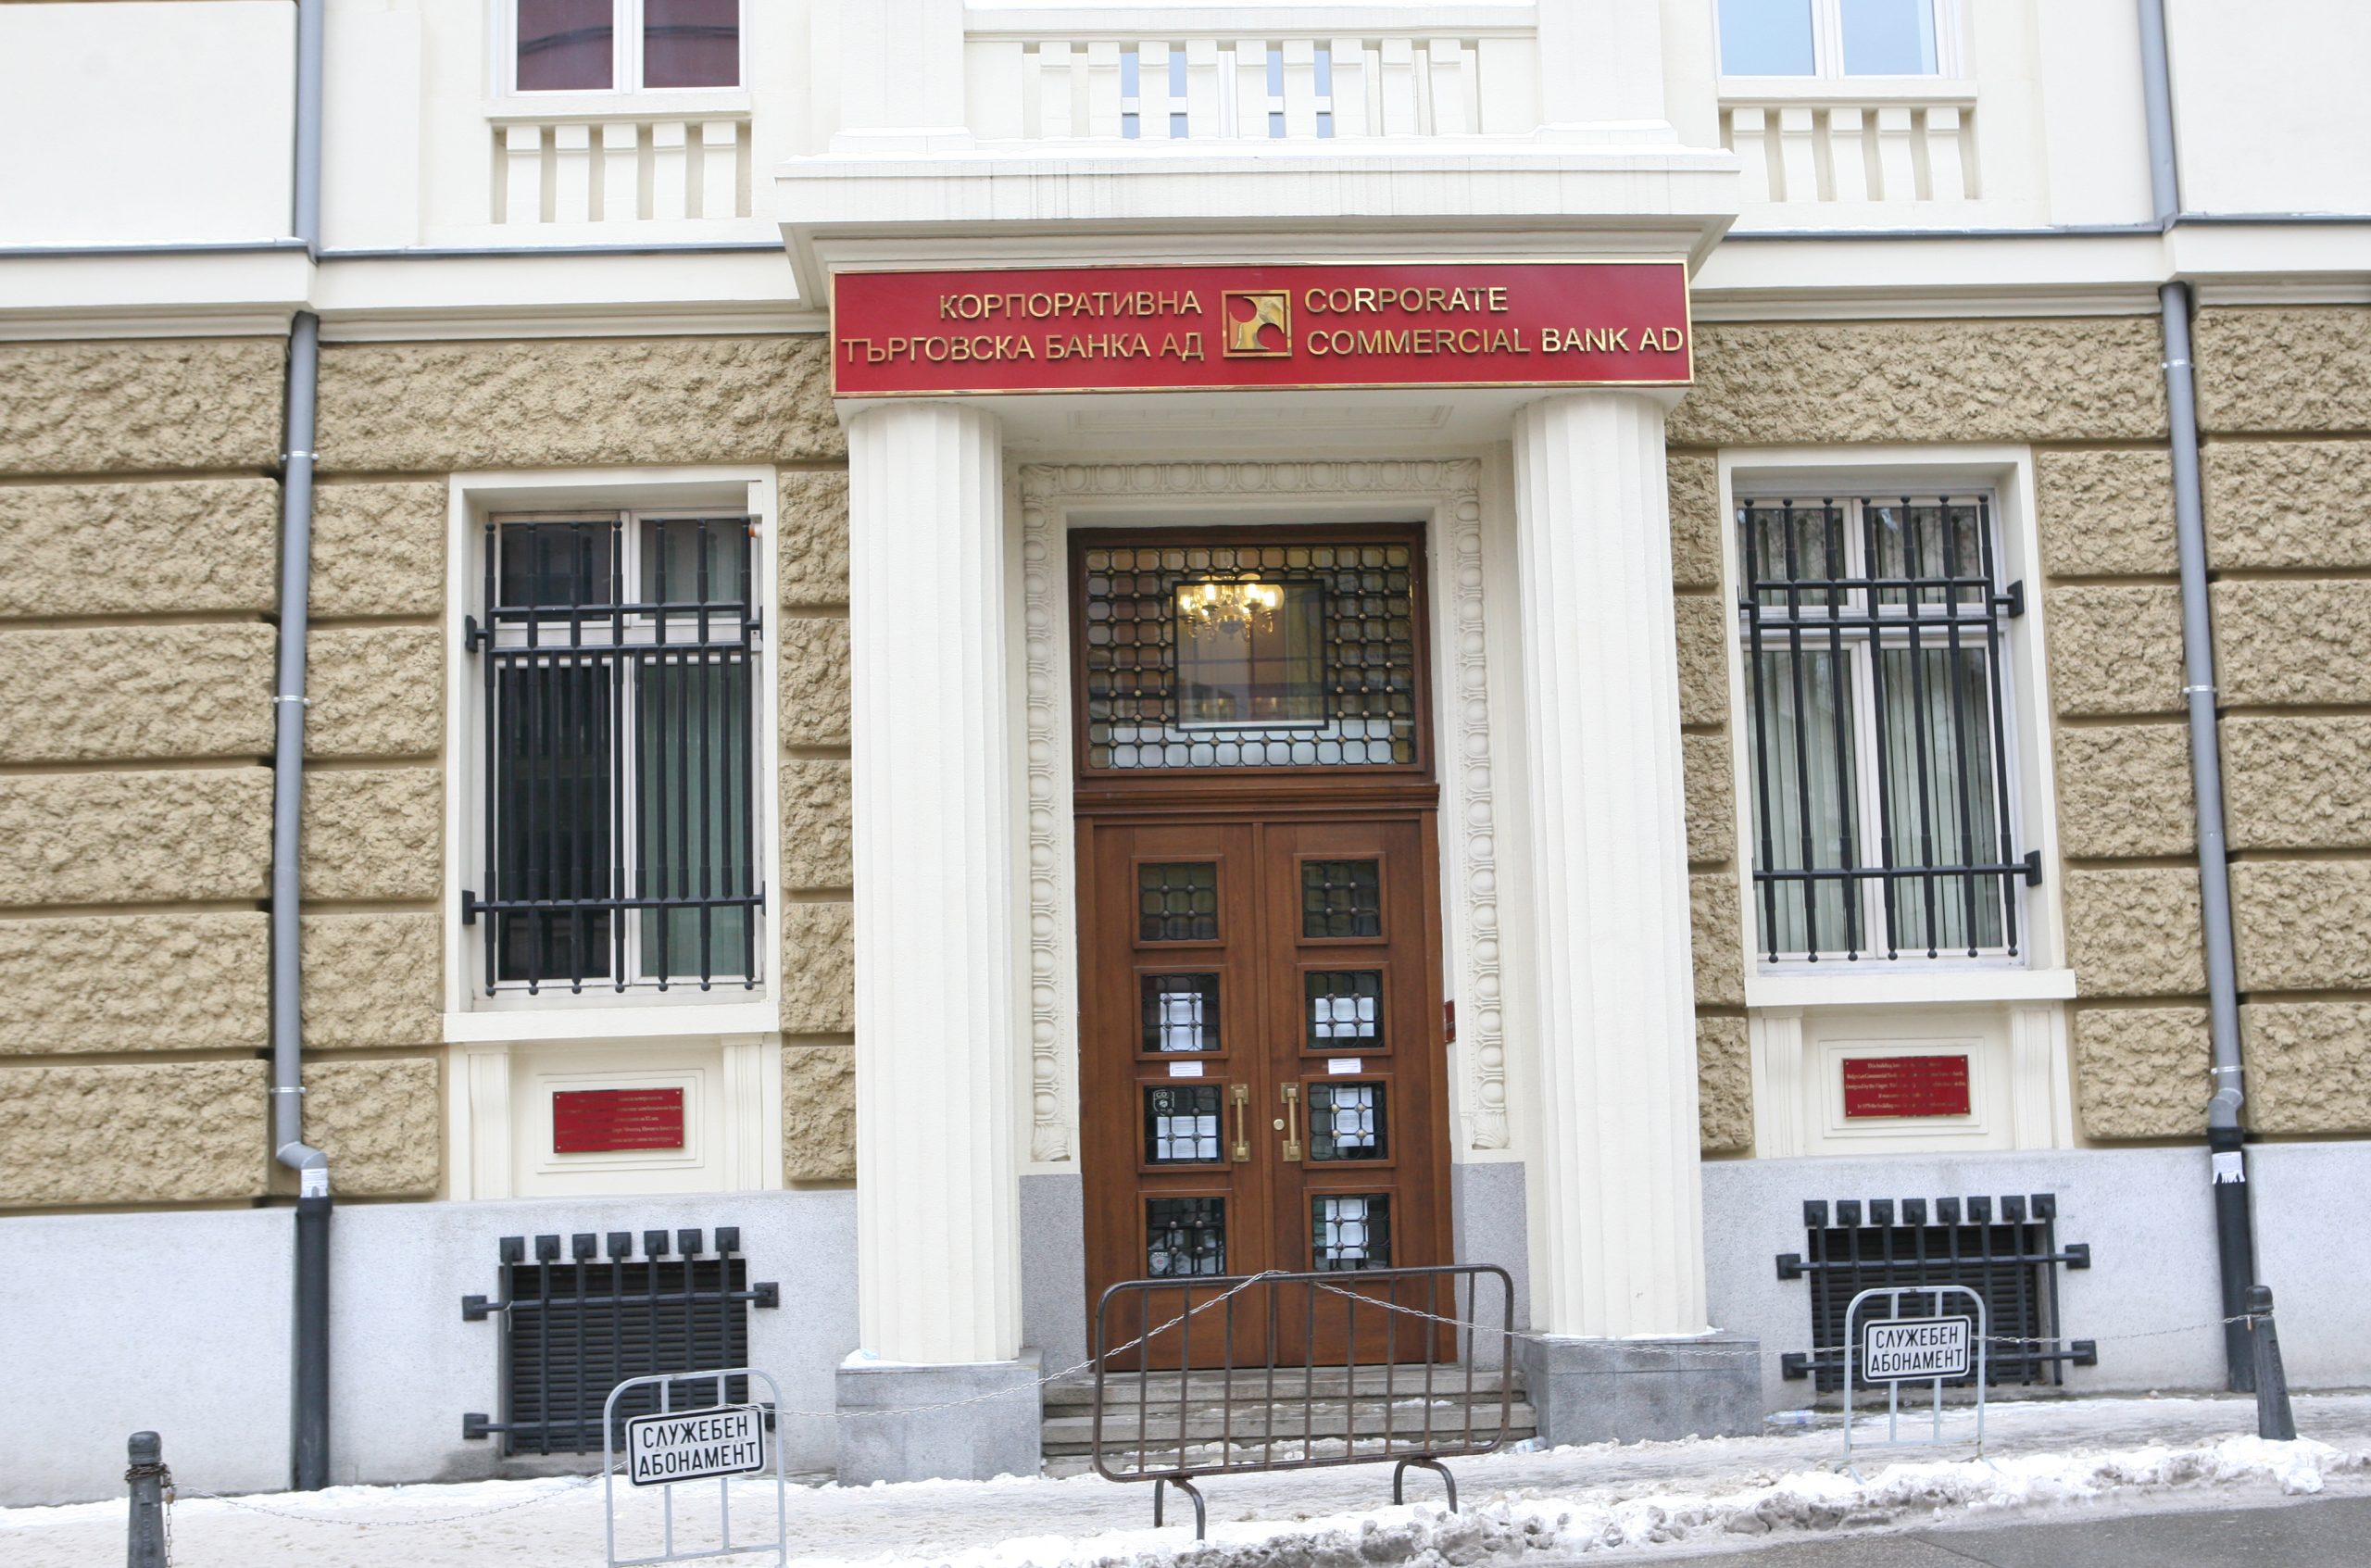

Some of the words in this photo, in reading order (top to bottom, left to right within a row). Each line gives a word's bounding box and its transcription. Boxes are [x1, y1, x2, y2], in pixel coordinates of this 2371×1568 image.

[940, 290, 1202, 320] КОРПОРАТИВНА
[1304, 286, 1509, 314] CORPORATE
[841, 334, 1035, 363] ТЪРГОВСКА
[1046, 332, 1151, 359] БАНКА
[1160, 332, 1205, 362] АД
[1307, 328, 1532, 356] COMMERCIAL
[1541, 328, 1631, 353] BANK
[1638, 327, 1684, 353] AD
[1875, 1325, 1959, 1348] СЛУЖЕБЕН
[1871, 1348, 1963, 1373] АБОНАМЕНТ
[643, 1415, 748, 1449] СЛУЖЕБЕН
[639, 1441, 756, 1477] АБОНАМЕНТ
